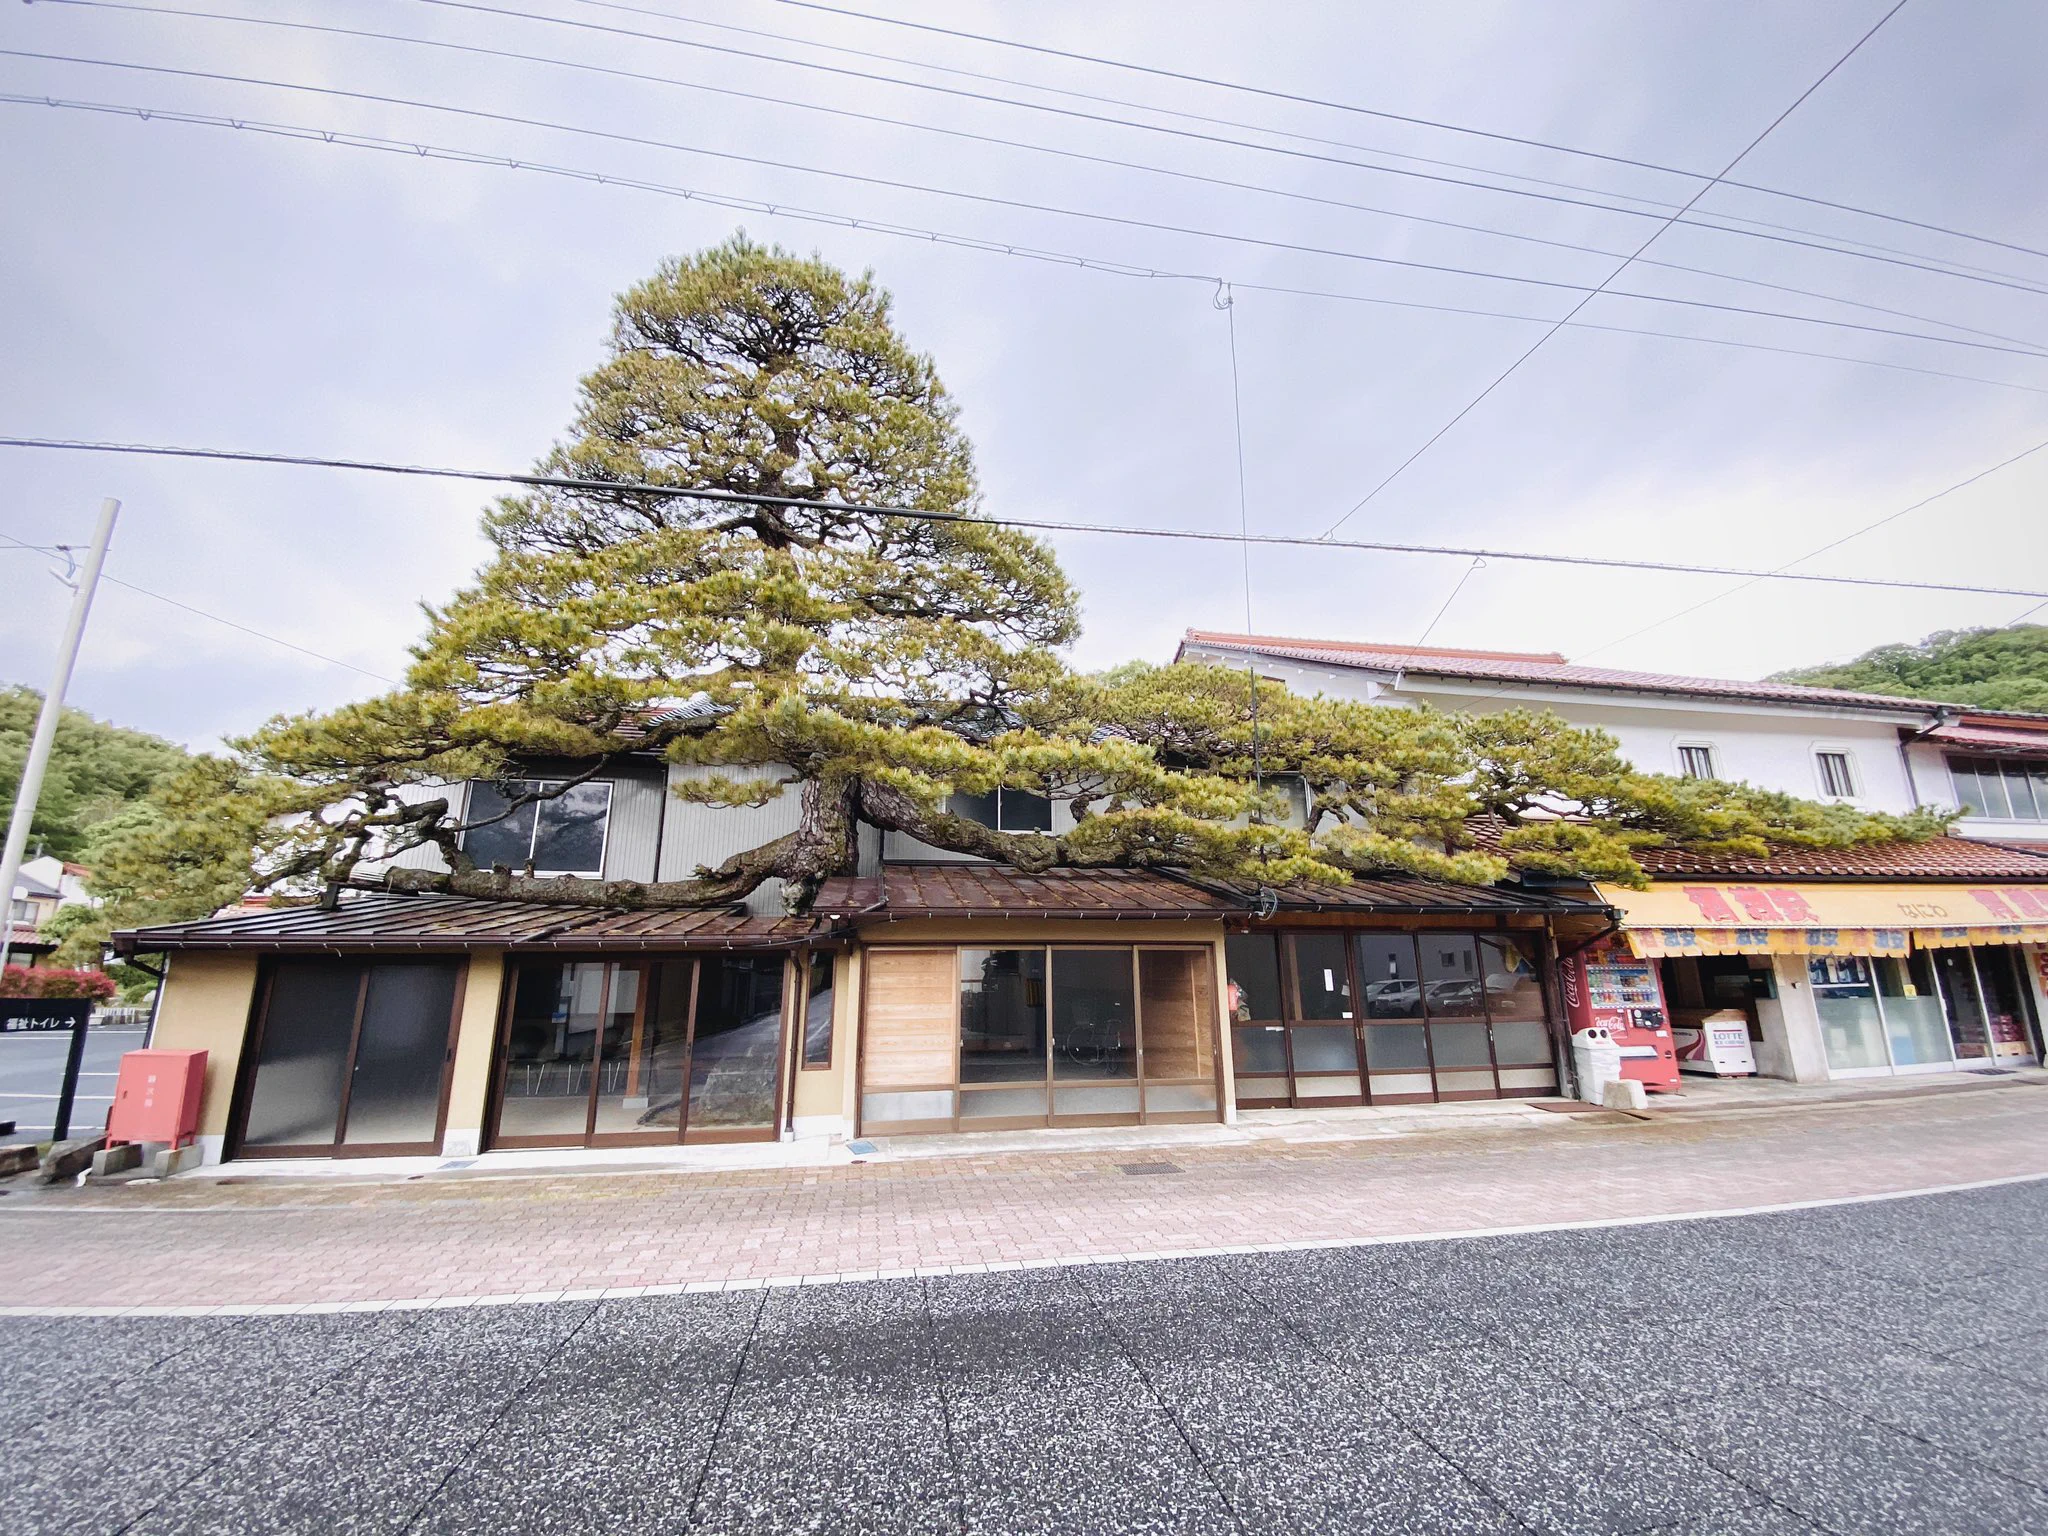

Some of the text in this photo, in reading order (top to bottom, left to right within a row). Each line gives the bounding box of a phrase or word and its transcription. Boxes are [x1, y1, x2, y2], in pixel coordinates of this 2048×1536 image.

[1897, 903, 1948, 919] なにわ
[1713, 1032, 1744, 1040] LOTTE
